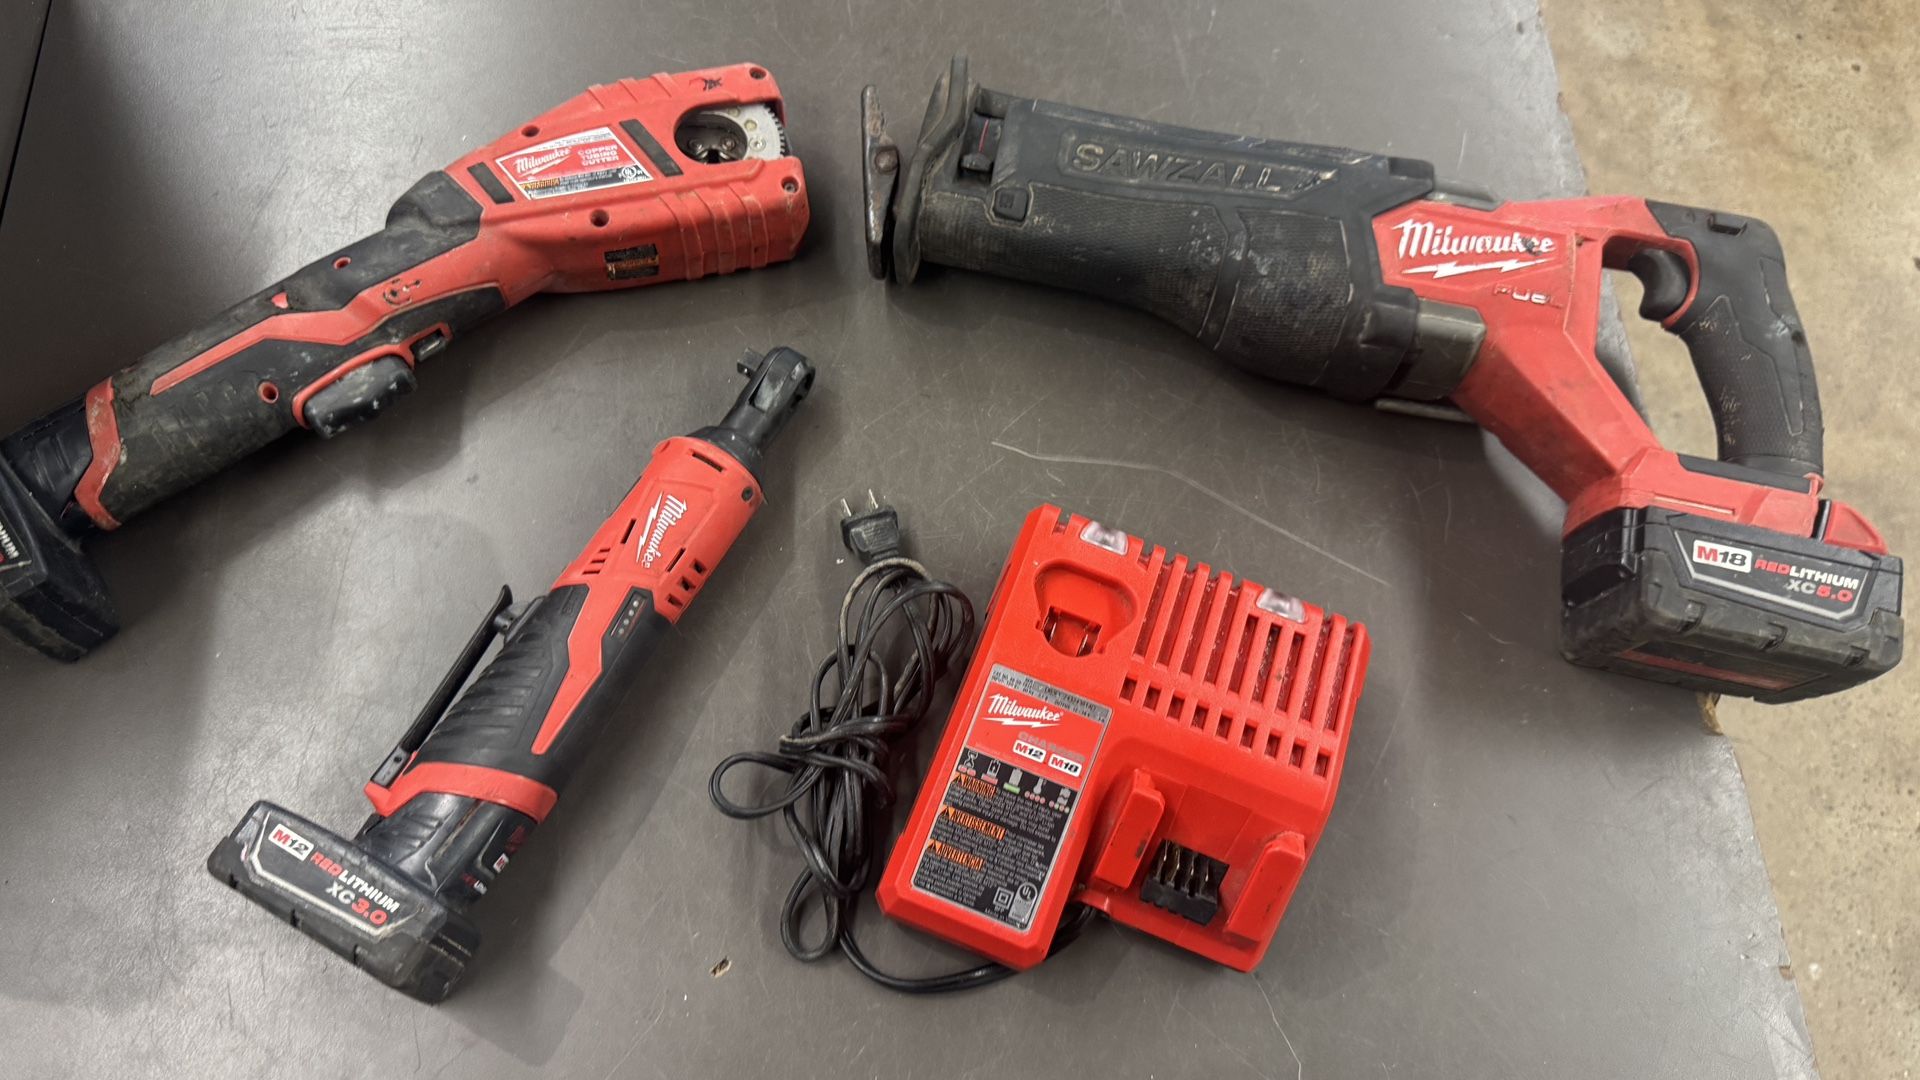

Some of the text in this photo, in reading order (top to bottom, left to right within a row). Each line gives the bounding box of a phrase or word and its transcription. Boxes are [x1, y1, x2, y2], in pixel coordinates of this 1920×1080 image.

[513, 148, 570, 173] Milwaukee
[578, 144, 618, 155] COPPER
[582, 150, 618, 160] TUBING
[582, 156, 619, 166] CUTTER
[1073, 144, 1281, 192] SAWZALL
[1392, 218, 1556, 259] Milwaukee
[642, 494, 687, 568] Milwaukee
[1697, 546, 1859, 589] M18 REDLITHIUM
[1786, 578, 1853, 602] XC5.0
[988, 693, 1061, 721] Milwaukee
[1015, 742, 1079, 773] M12 M18
[272, 829, 400, 913] M12 REDLITHIUM
[325, 881, 388, 926] XC3.0
